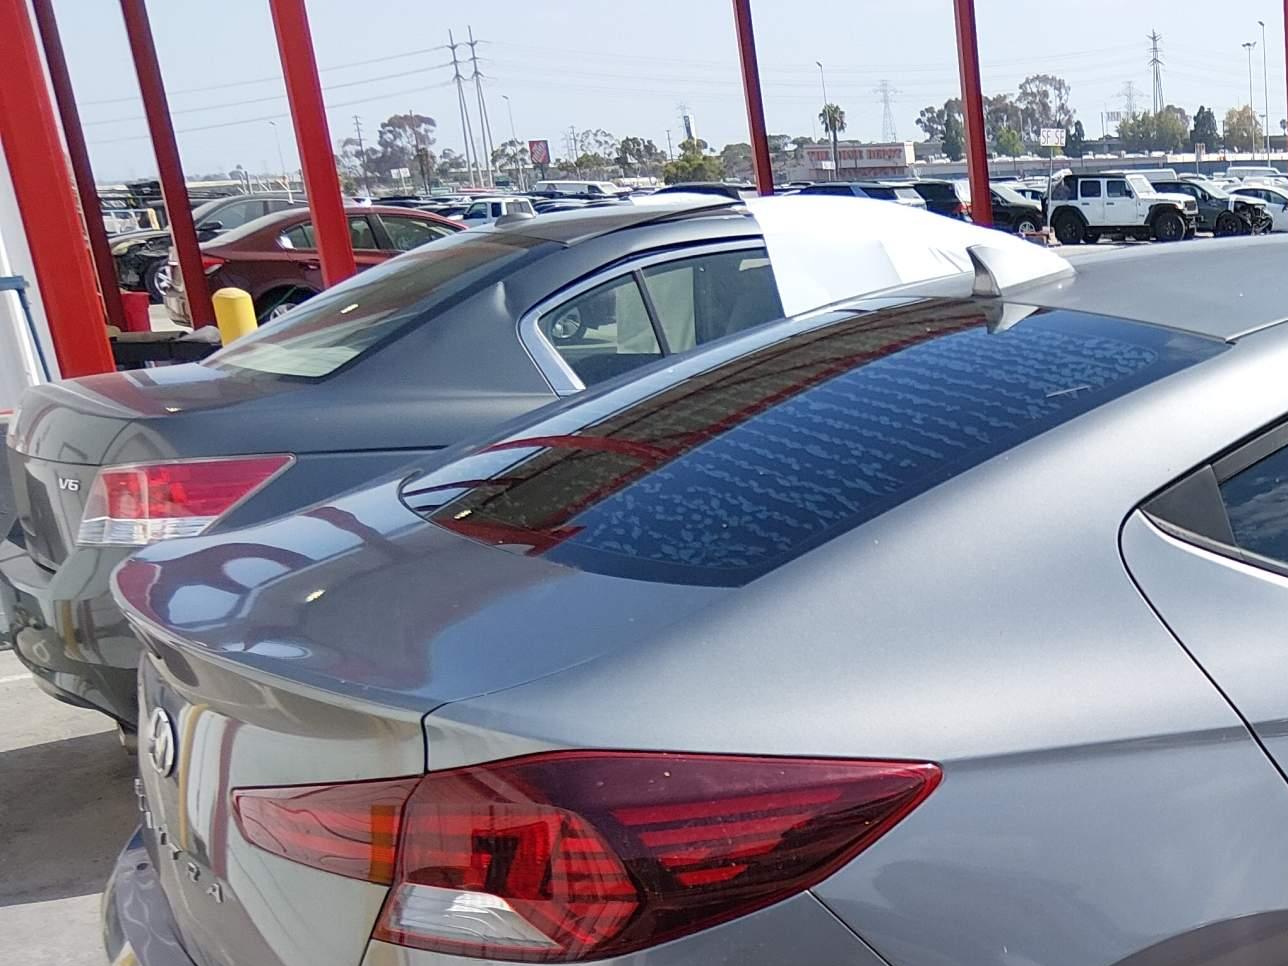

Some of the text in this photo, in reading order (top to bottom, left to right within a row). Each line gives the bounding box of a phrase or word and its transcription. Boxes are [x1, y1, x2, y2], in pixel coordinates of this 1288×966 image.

[1041, 129, 1065, 146] SF SE
[59, 477, 80, 491] V6
